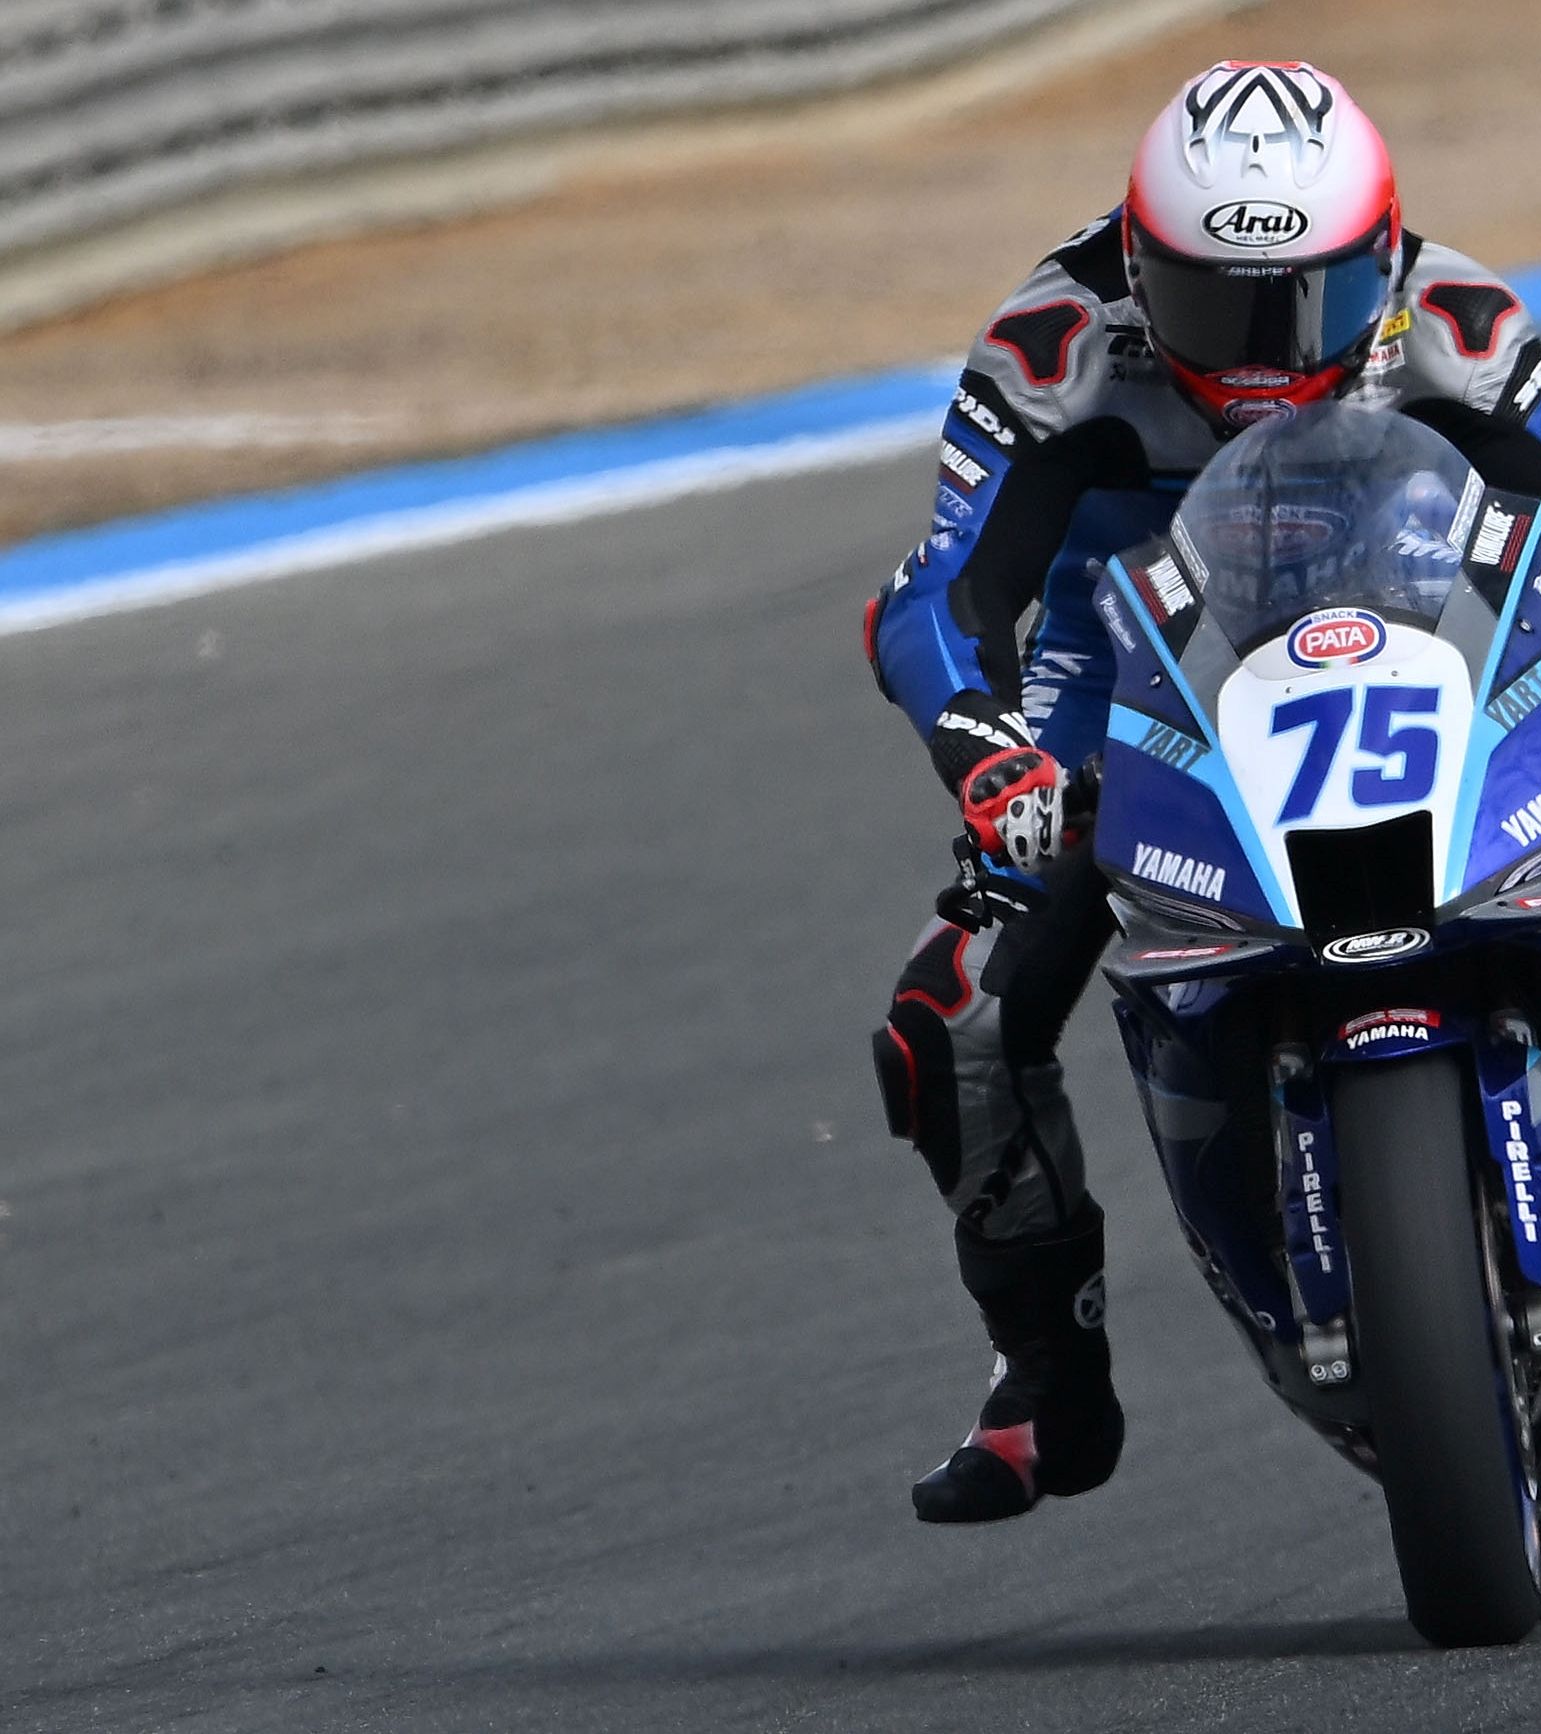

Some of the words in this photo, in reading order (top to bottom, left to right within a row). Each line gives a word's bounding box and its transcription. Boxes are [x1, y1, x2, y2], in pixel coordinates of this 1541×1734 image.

[1215, 206, 1296, 234] Arai
[1305, 627, 1366, 653] PATA
[1312, 609, 1357, 624] SNACK
[1138, 721, 1209, 772] YART
[1271, 684, 1440, 827] 75
[1131, 842, 1226, 902] YAMAHA
[1346, 1025, 1429, 1050] YAMAHA
[1500, 1100, 1537, 1243] PIRELLI
[1297, 1131, 1334, 1274] PIRELLI
